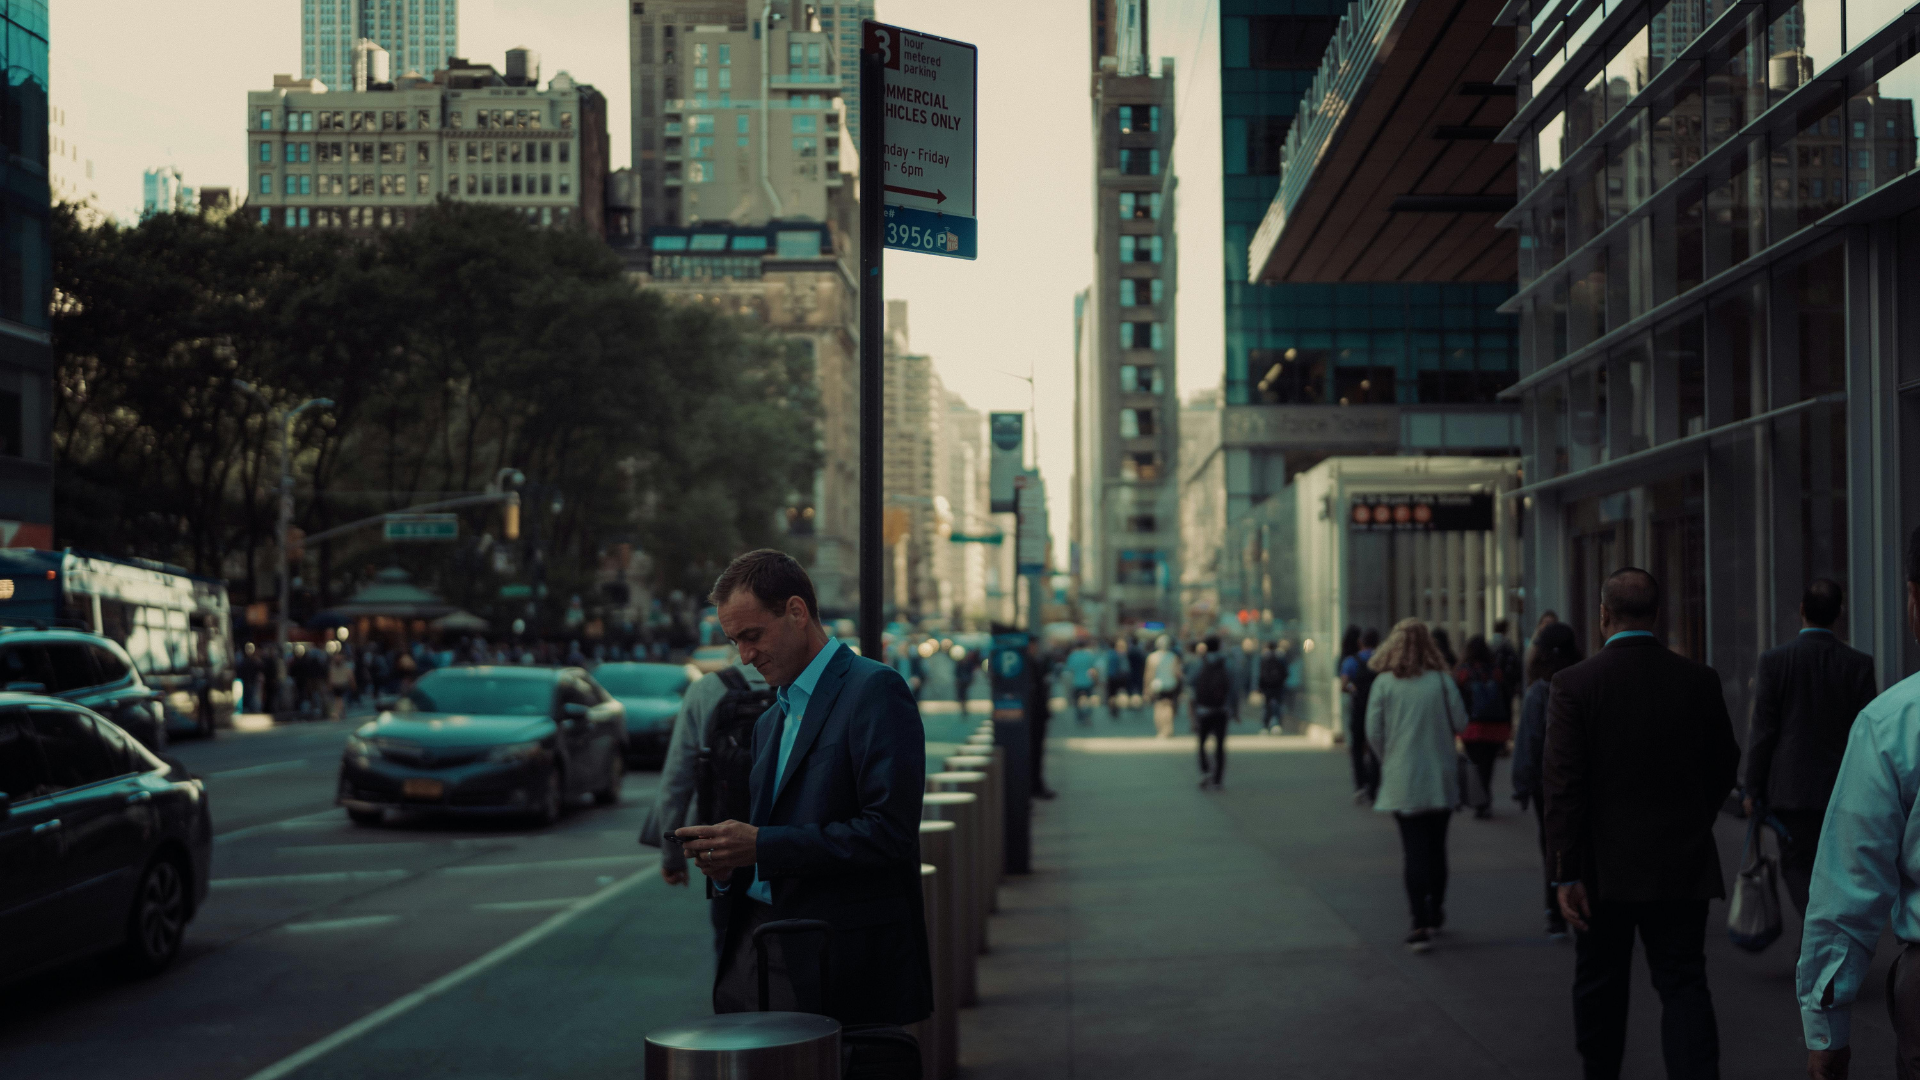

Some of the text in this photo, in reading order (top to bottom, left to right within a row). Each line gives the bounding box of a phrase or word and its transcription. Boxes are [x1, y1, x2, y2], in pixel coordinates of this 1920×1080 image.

[874, 29, 892, 64] 3
[904, 36, 924, 50] hour
[904, 51, 941, 67] metered
[904, 64, 937, 81] parking
[883, 83, 949, 110] MMERCIAL
[884, 102, 961, 131] HICLES ONLY
[883, 143, 909, 161] nday
[918, 148, 950, 168] Friday
[901, 162, 924, 177] 6pm
[1001, 650, 1019, 675] P
